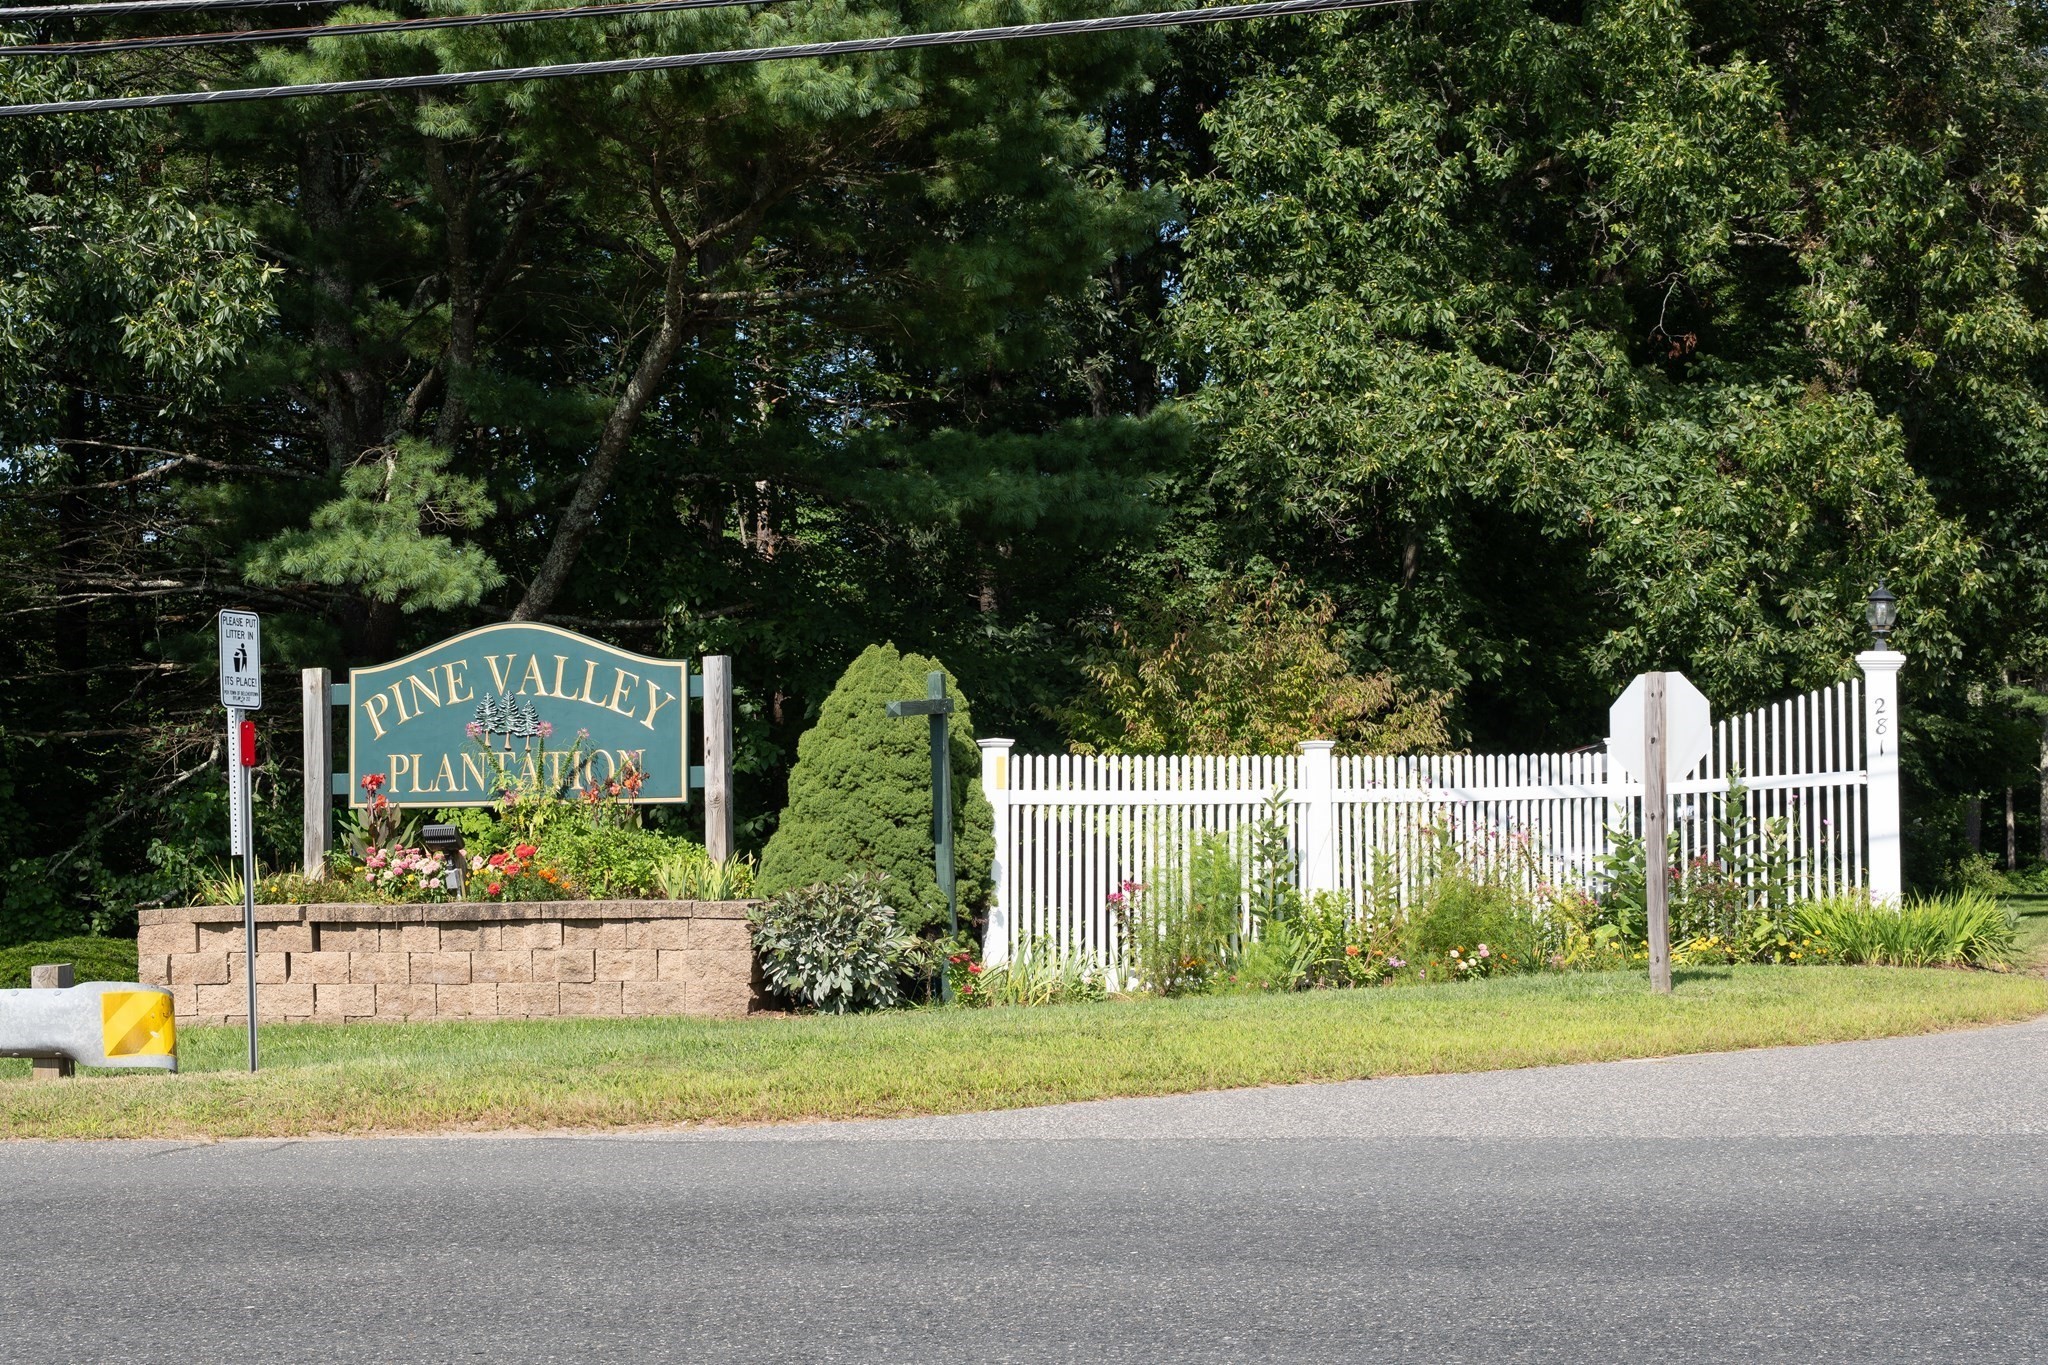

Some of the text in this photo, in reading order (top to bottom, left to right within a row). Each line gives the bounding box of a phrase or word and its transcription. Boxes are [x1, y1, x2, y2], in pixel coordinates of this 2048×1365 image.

[223, 616, 256, 628] PLEASE PUT
[226, 630, 254, 640] LITTER IN
[225, 676, 257, 687] ITS PLACE!
[361, 653, 677, 741] PINE VALLEY
[387, 748, 646, 794] PLANTATION
